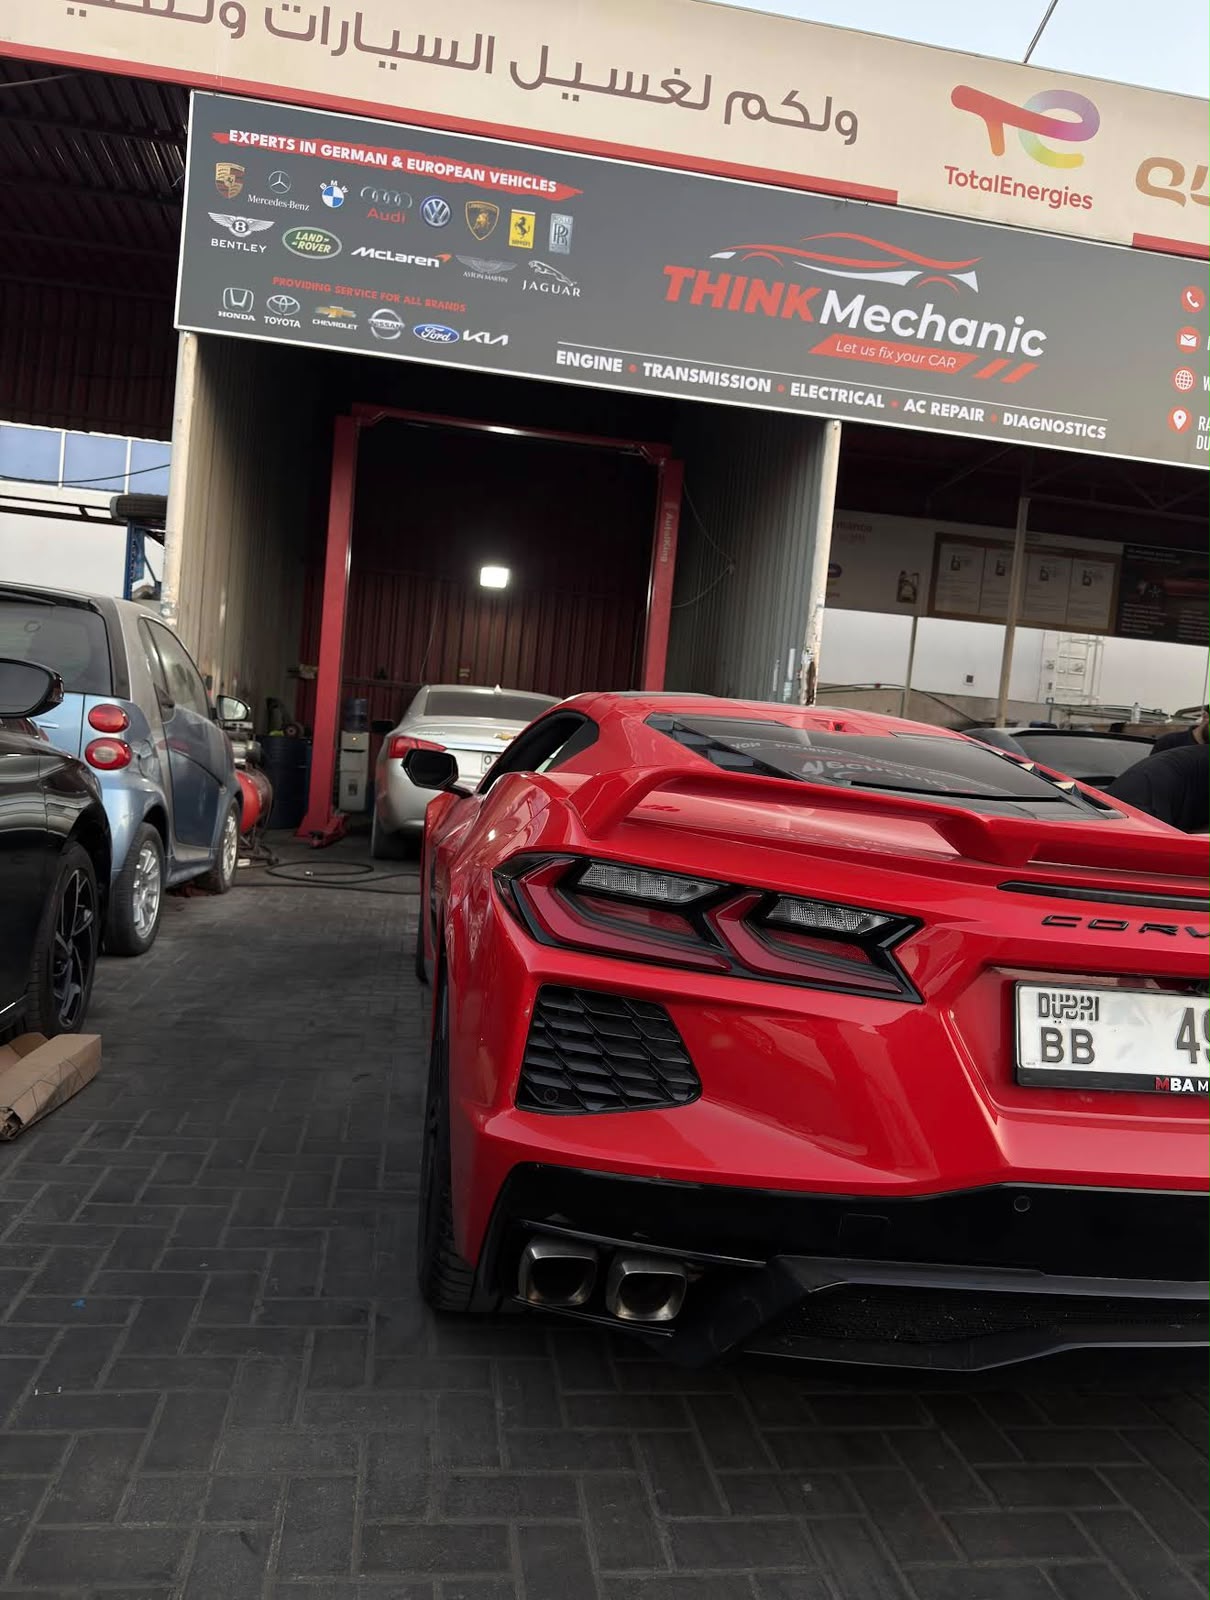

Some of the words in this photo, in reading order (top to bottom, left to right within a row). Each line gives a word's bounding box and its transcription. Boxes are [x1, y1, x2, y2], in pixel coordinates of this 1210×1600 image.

[265, 3, 495, 74] السيارات
[510, 45, 712, 111] لغسيل
[724, 90, 858, 145] ولكم
[229, 130, 296, 151] EXPERTS
[300, 140, 316, 154] IN
[321, 144, 388, 166] GERMAN
[391, 156, 403, 168] &
[407, 158, 485, 182] EUROPEAN
[490, 171, 557, 193] VEHICLES
[320, 180, 349, 193] BMW
[944, 165, 1093, 210] TotalEnergies
[247, 194, 310, 212] Mercedes-Benz
[367, 207, 406, 224] Audi
[210, 238, 268, 253] BENTLEY
[295, 231, 324, 243] LAND
[297, 240, 332, 253] ROVER
[351, 246, 440, 268] McLaren
[272, 276, 331, 293] PROVIDING
[334, 285, 378, 300] SERVICE
[380, 291, 400, 303] FOR
[404, 296, 422, 306] ALL
[425, 298, 467, 312] BRANDS
[522, 280, 581, 297] JAGUAR
[218, 310, 256, 322] HONDA
[663, 265, 822, 323] THINK
[819, 289, 1048, 357] Mechanic
[264, 315, 301, 328] TOYOTA
[312, 318, 359, 331] CHEVROLET
[421, 326, 451, 342] Ford
[463, 330, 509, 346] KIA
[835, 340, 857, 354] Let
[860, 345, 876, 356] us
[879, 346, 894, 359] fix
[895, 350, 925, 364] your
[928, 354, 957, 368] CAR
[556, 350, 623, 373] ENGINE
[643, 362, 772, 393] TRANSMISSION
[790, 382, 885, 408] ELECTRICAL
[904, 399, 926, 414] AC
[930, 402, 984, 422] REPAIR
[1003, 412, 1107, 439] DIAGNOSTICS
[1041, 1027, 1095, 1064] BB
[1155, 1076, 1195, 1092] MBA
